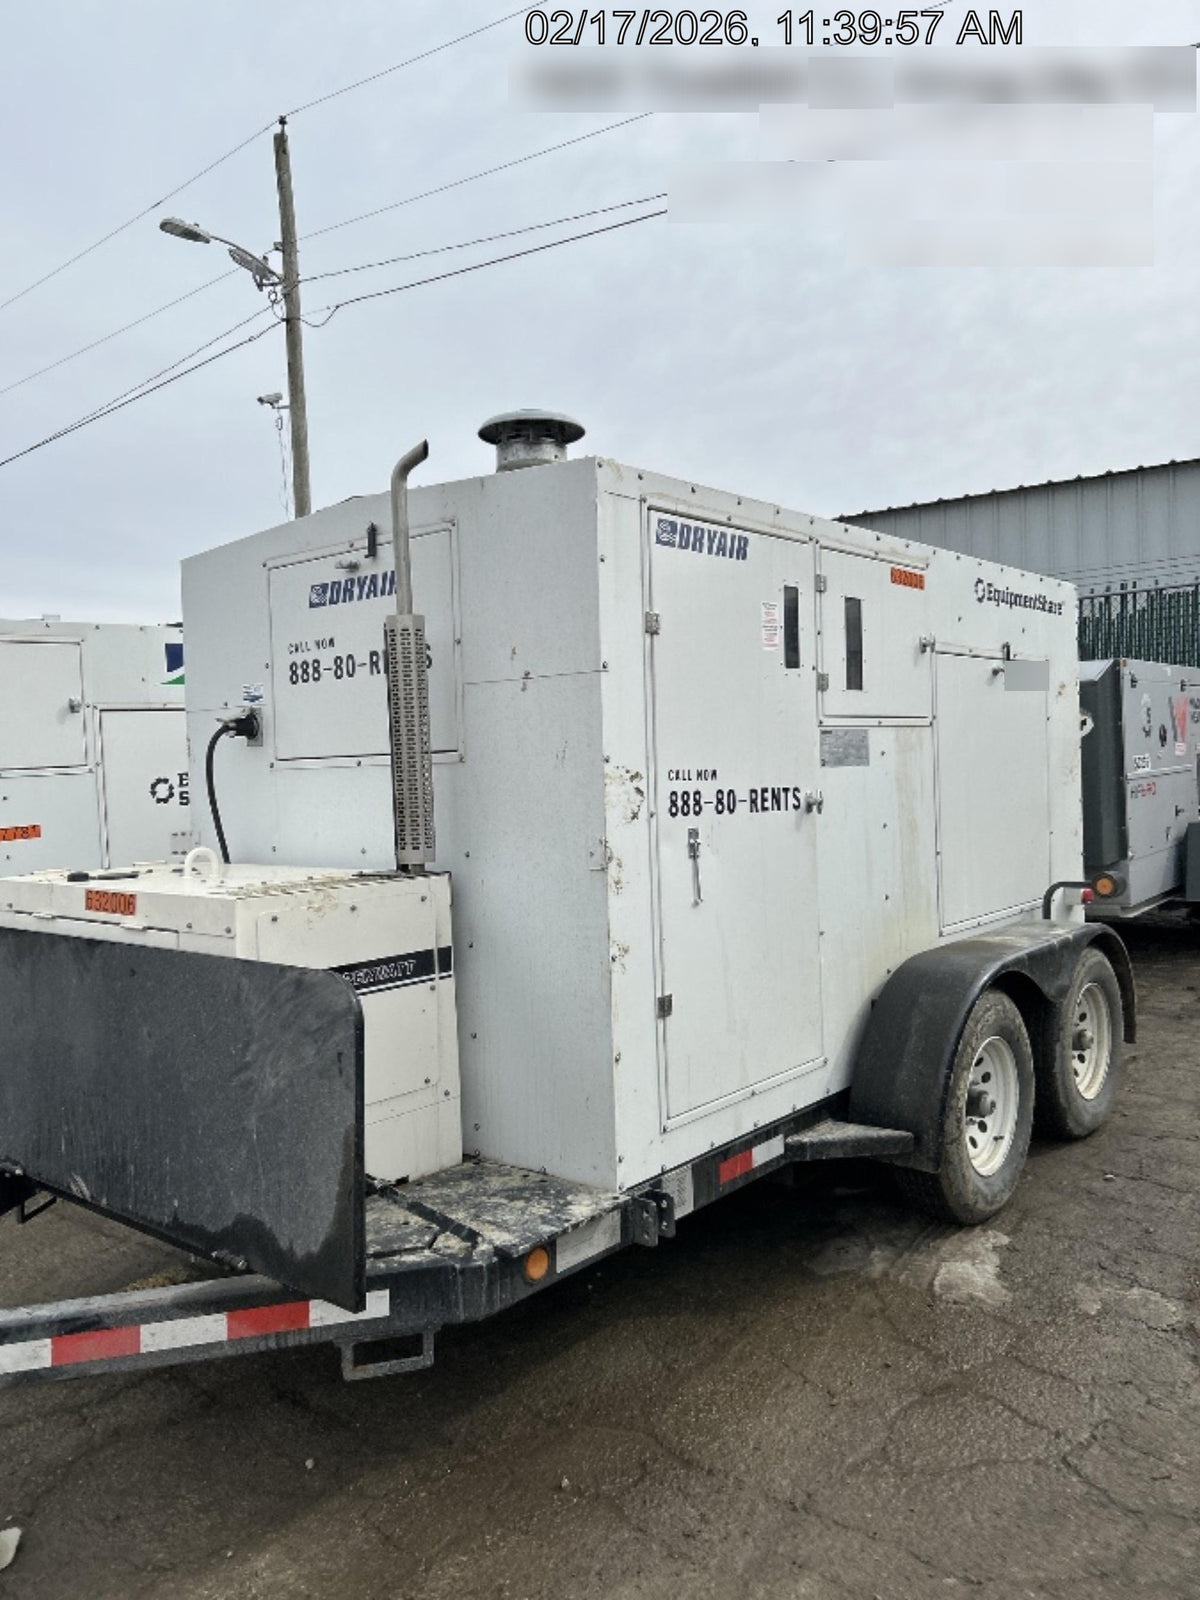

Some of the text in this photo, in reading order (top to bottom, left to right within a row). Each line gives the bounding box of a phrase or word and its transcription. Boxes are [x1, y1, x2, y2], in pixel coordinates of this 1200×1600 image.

[677, 522, 749, 561] DRYAIR
[288, 641, 311, 654] CALL
[668, 769, 718, 781] CALL NOW
[668, 786, 801, 818] 888-80-RENTS
[86, 890, 135, 916] 632006
